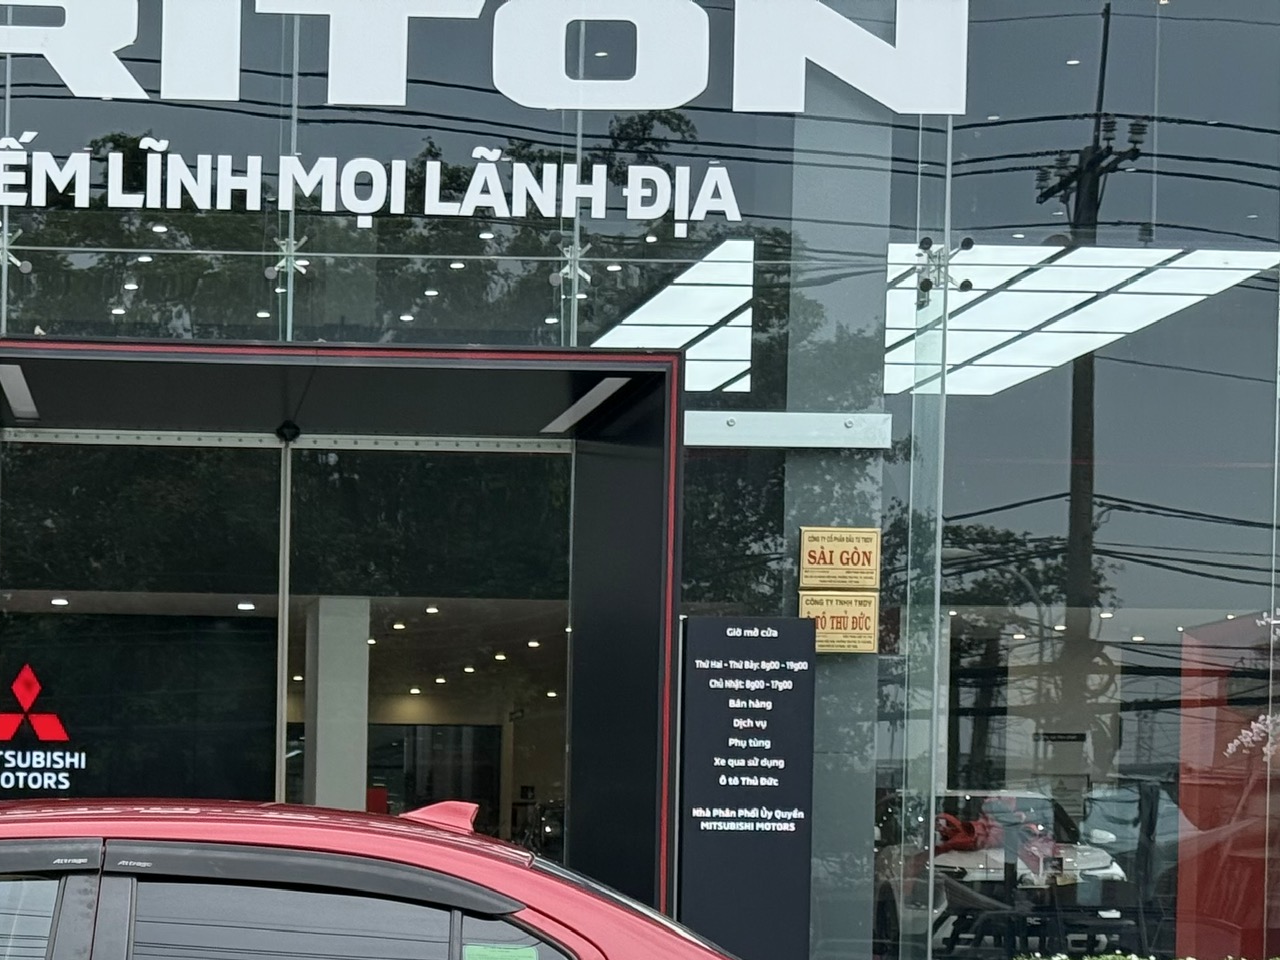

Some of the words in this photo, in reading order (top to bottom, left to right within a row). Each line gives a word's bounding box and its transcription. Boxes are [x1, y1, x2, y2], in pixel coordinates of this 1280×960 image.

[107, 136, 262, 211] LĨNH
[278, 155, 406, 229] MỌI
[424, 146, 607, 219] LÃNH
[622, 164, 742, 238] ĐỊA
[807, 545, 834, 566] SÀI
[840, 546, 873, 567] GÒN
[805, 598, 824, 606] CÔNG
[825, 598, 834, 606] TY
[835, 599, 853, 607] TNHH
[815, 611, 827, 630] TÔ
[830, 610, 849, 631] THỦ
[851, 611, 871, 631] ĐỨC
[726, 627, 742, 637] Giờ
[760, 627, 778, 637] cửa
[695, 660, 710, 669] Thứ
[710, 660, 723, 669] Hai
[729, 660, 743, 669] Thứ
[709, 678, 724, 689] Chủ
[728, 699, 747, 708] Bán
[749, 699, 773, 710] hàng
[733, 719, 753, 729] Dịch
[755, 720, 767, 729] vụ
[728, 738, 747, 749] Phụ
[748, 739, 771, 749] tùng
[713, 757, 726, 766] Xe
[727, 759, 746, 768] qua
[747, 757, 760, 767] sử
[760, 758, 785, 769] dụng
[719, 775, 727, 786] Ô
[728, 776, 739, 786] tô
[740, 776, 759, 786] Thủ
[760, 776, 779, 786] Đức
[700, 821, 754, 831] MITSUBISHI
[756, 822, 795, 832] MOTORS
